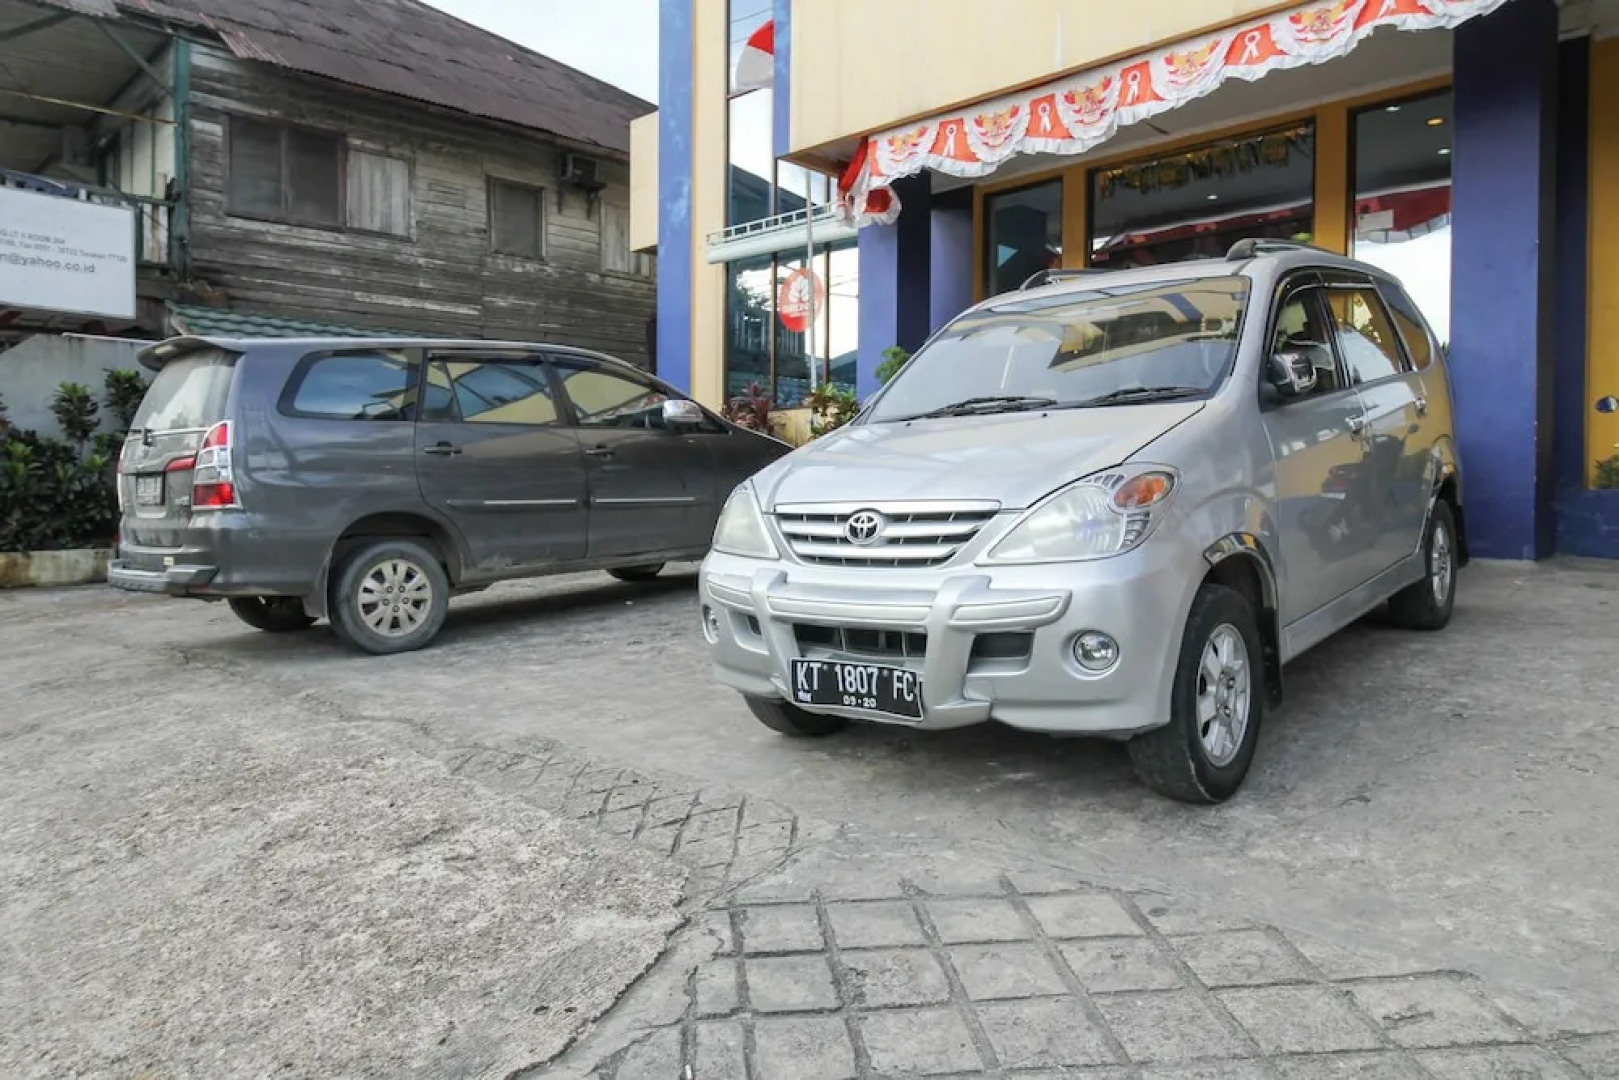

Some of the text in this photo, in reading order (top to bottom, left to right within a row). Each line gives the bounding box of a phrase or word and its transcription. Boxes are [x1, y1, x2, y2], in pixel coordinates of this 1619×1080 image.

[796, 661, 914, 702] KT 1807 FC
